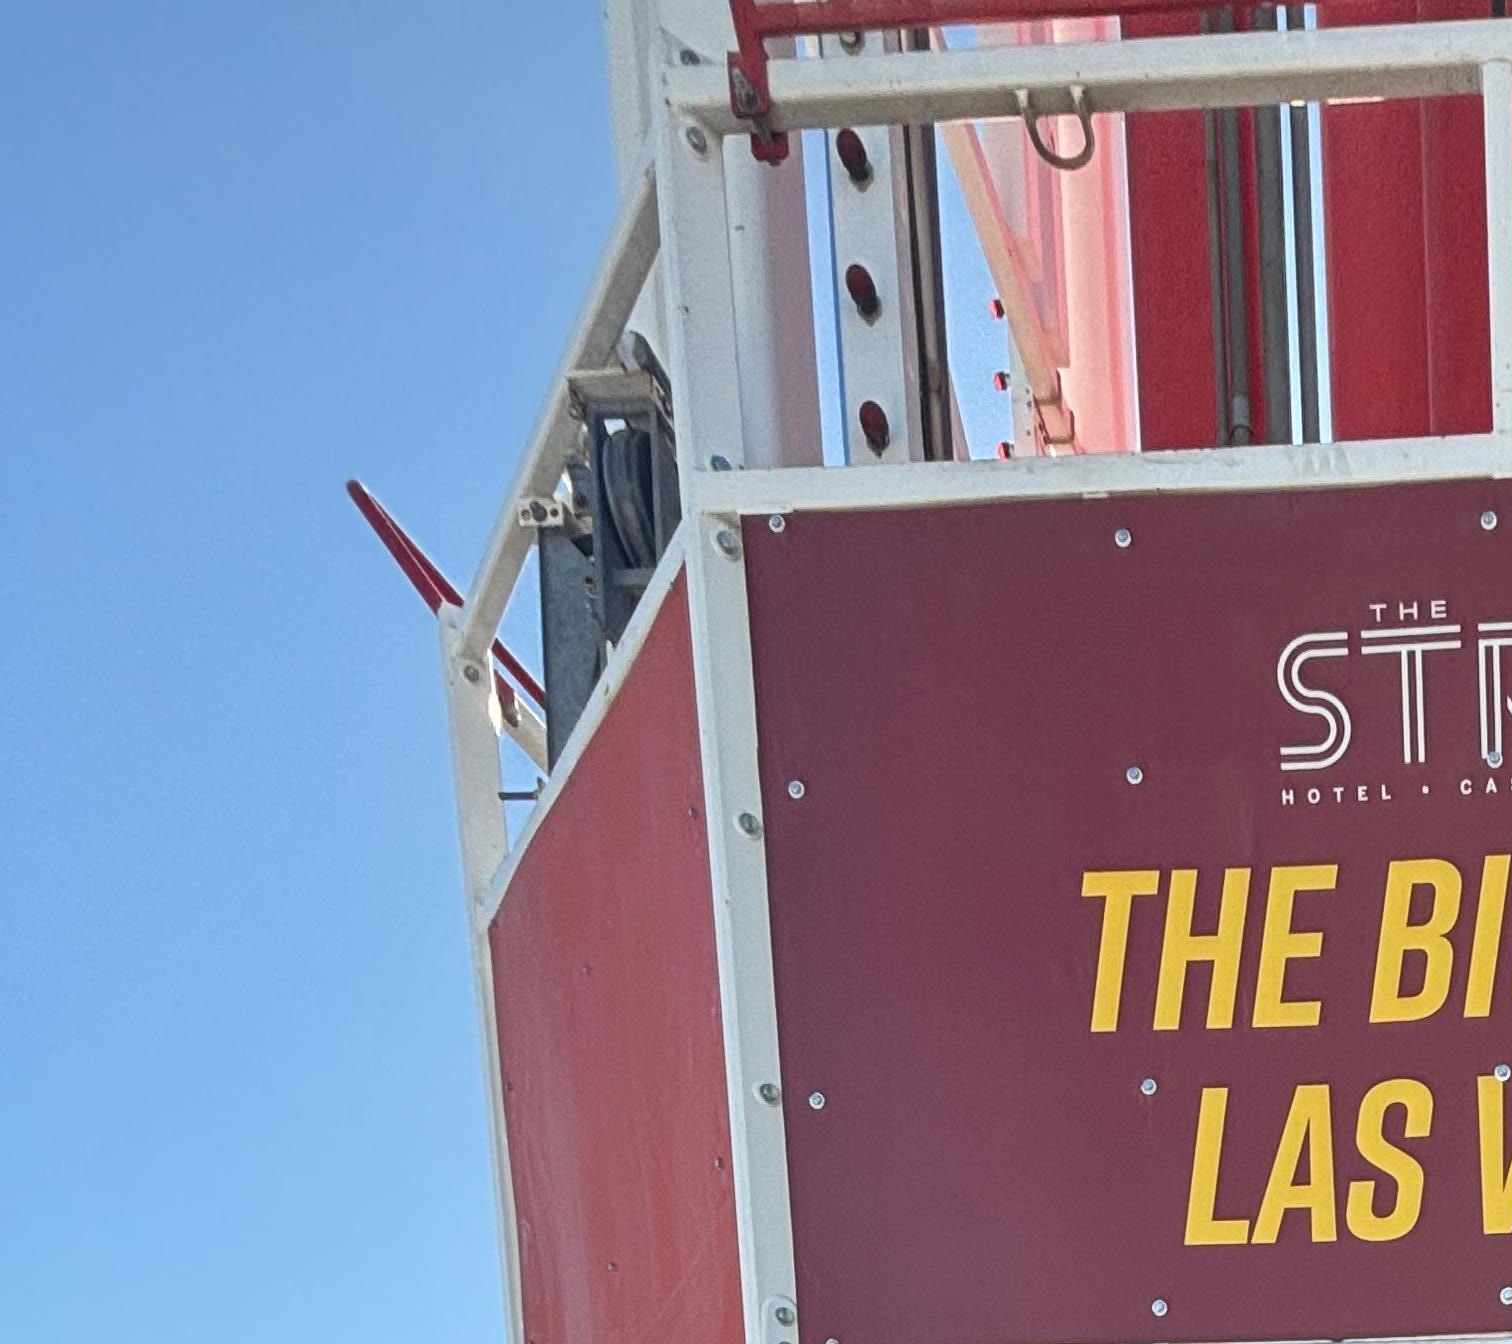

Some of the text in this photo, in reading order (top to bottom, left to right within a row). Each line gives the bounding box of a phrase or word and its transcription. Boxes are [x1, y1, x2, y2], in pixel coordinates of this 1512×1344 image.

[1369, 600, 1447, 622] THE
[1281, 784, 1392, 806] HOTEL
[1081, 864, 1339, 1033] THE
[1183, 1078, 1434, 1246] LAS
